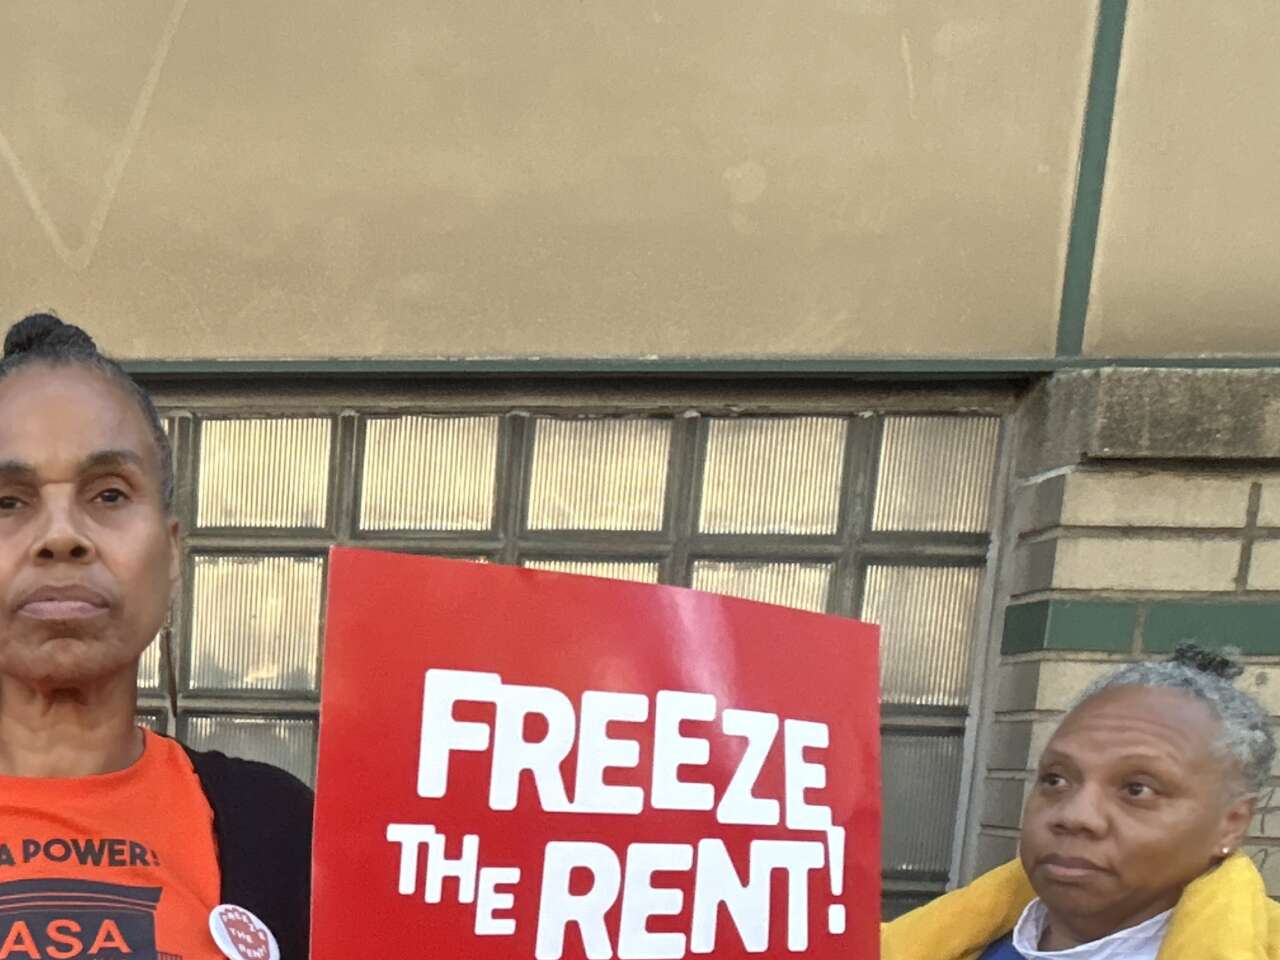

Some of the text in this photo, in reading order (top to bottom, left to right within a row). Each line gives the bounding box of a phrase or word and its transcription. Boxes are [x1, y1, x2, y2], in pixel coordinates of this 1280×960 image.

[416, 668, 832, 832] FREEZE
[386, 823, 846, 960] THE RENT!
